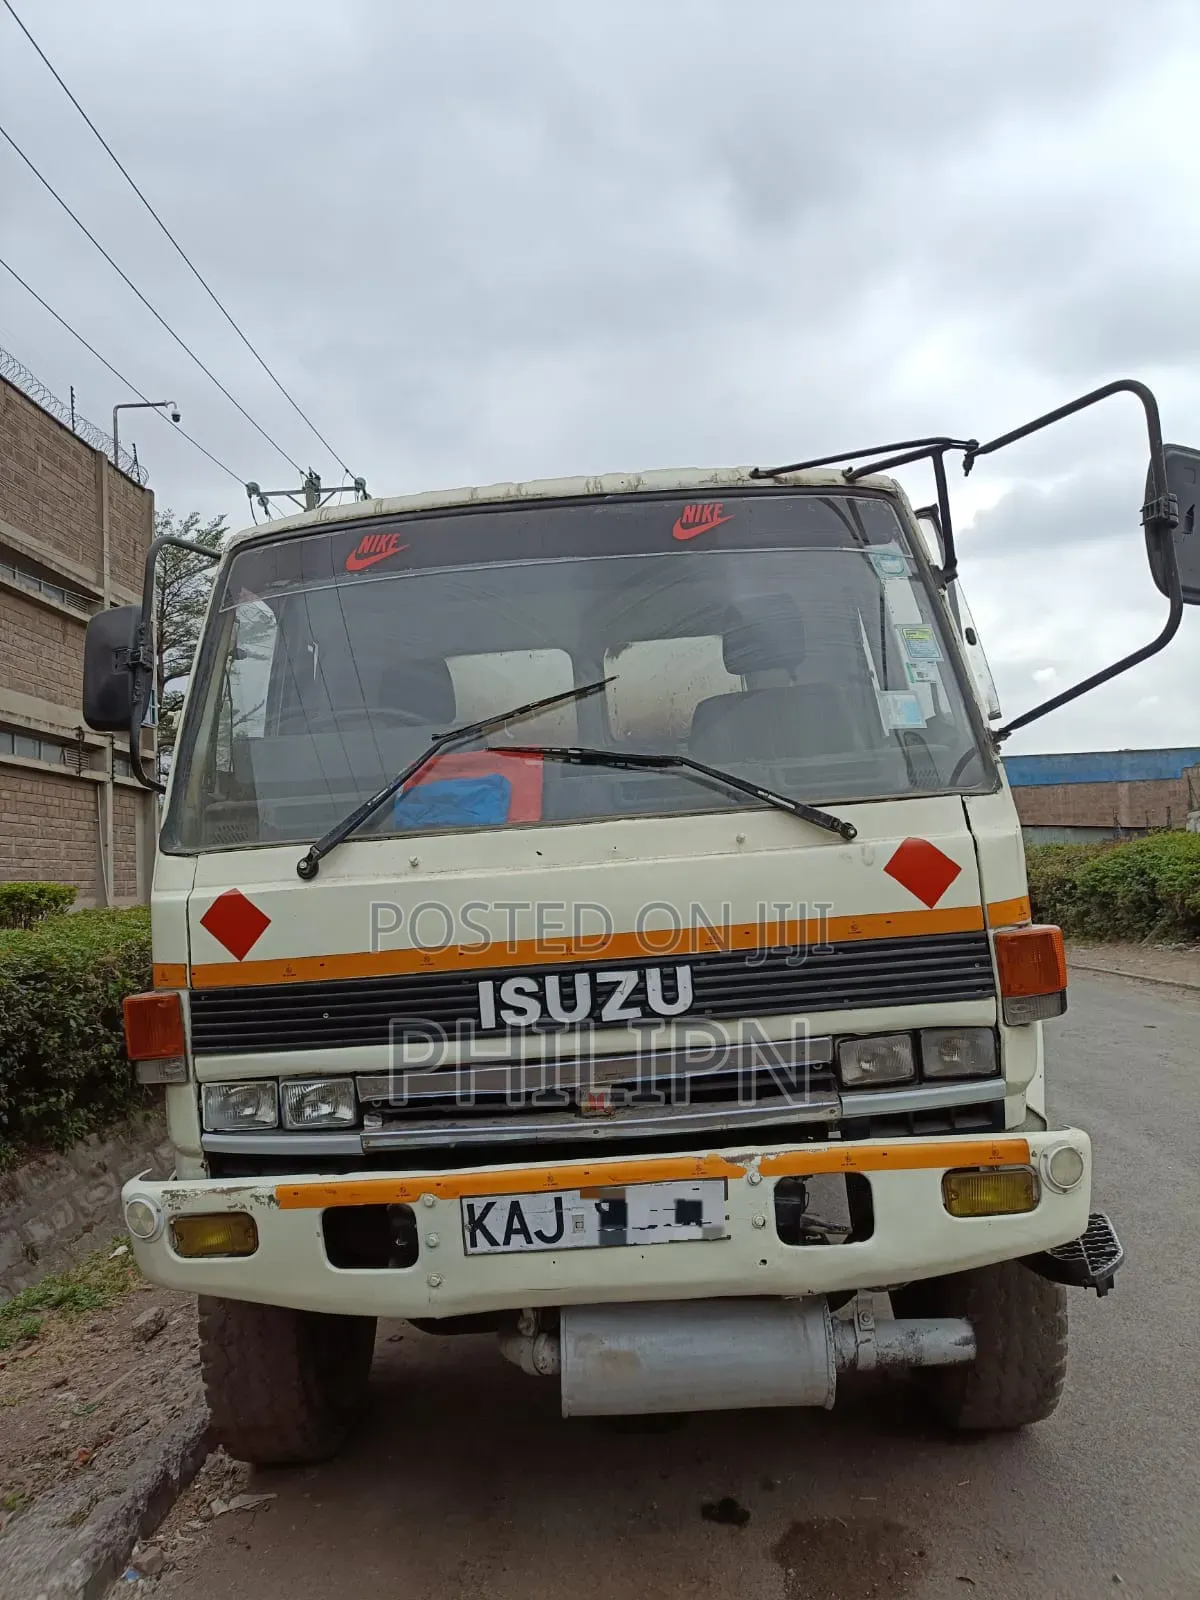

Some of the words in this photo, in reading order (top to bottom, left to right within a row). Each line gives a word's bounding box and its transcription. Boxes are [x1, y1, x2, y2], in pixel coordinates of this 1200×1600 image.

[682, 503, 724, 523] NIKE
[356, 533, 401, 554] NIKE
[477, 965, 694, 1029] ISUZU
[465, 1196, 565, 1249] KAJ
